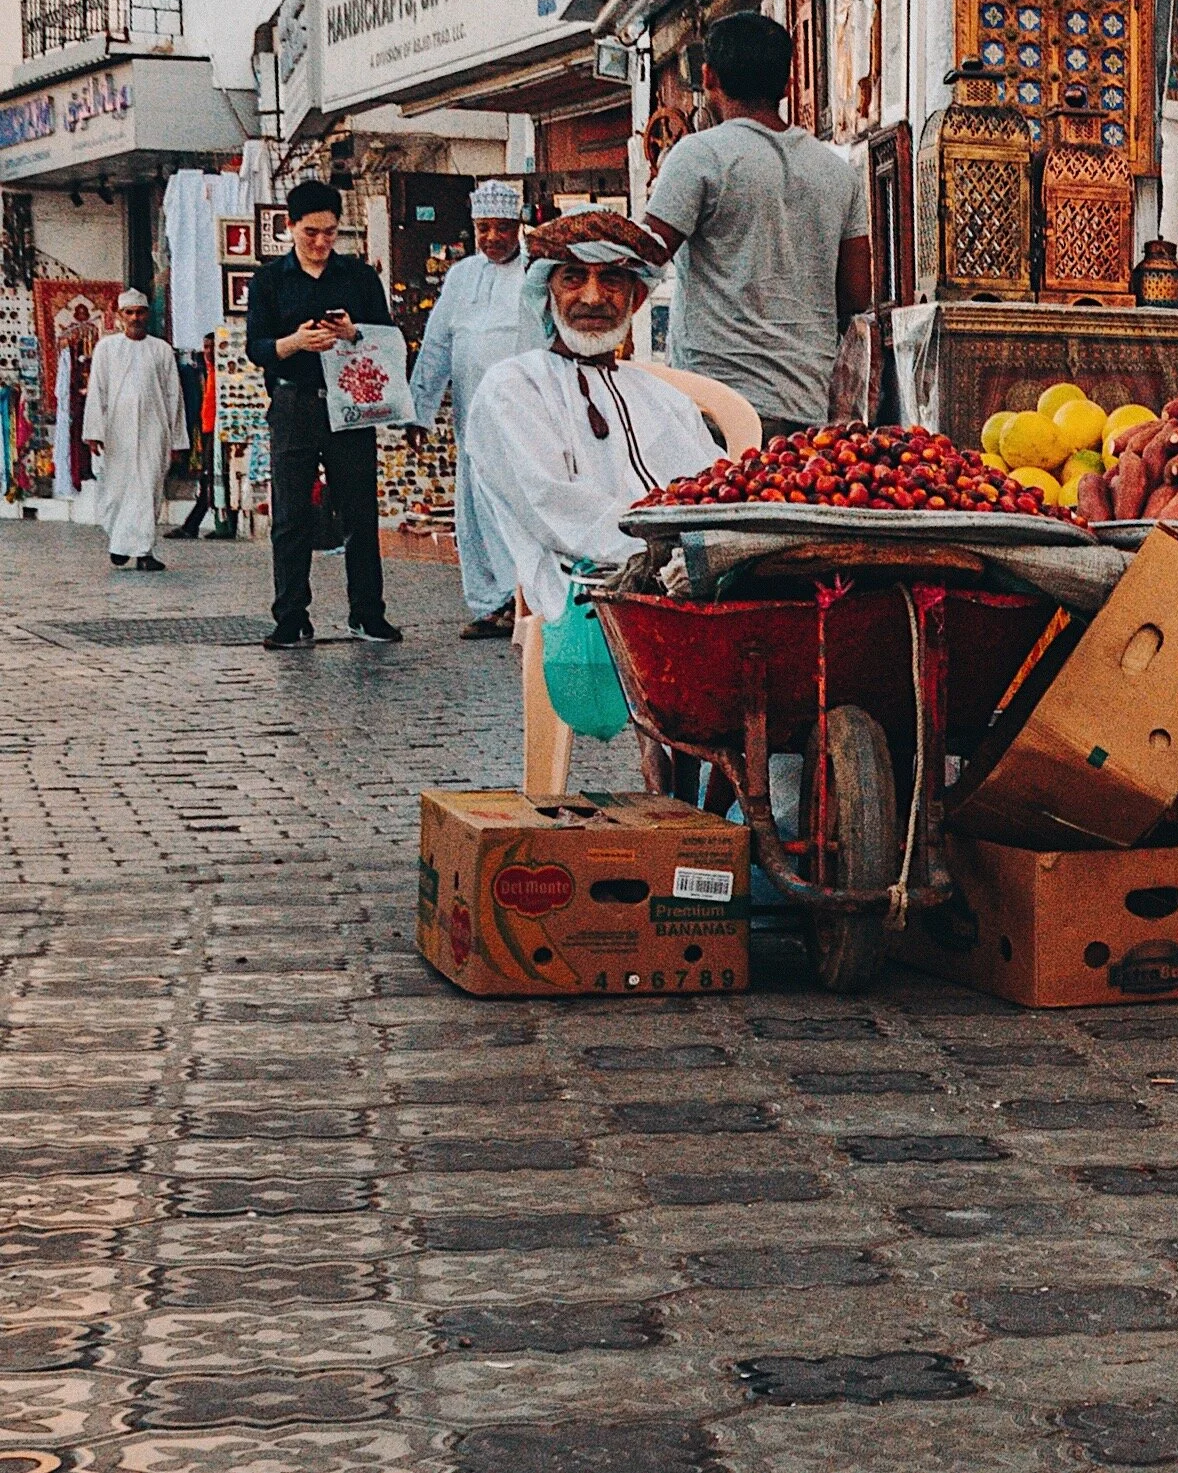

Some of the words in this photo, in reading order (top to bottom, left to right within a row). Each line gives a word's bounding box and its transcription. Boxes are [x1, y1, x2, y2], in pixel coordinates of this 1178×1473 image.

[500, 880, 522, 895] Del
[526, 880, 570, 895] Monte
[656, 905, 725, 918] Premium
[656, 923, 737, 937] BANANAS
